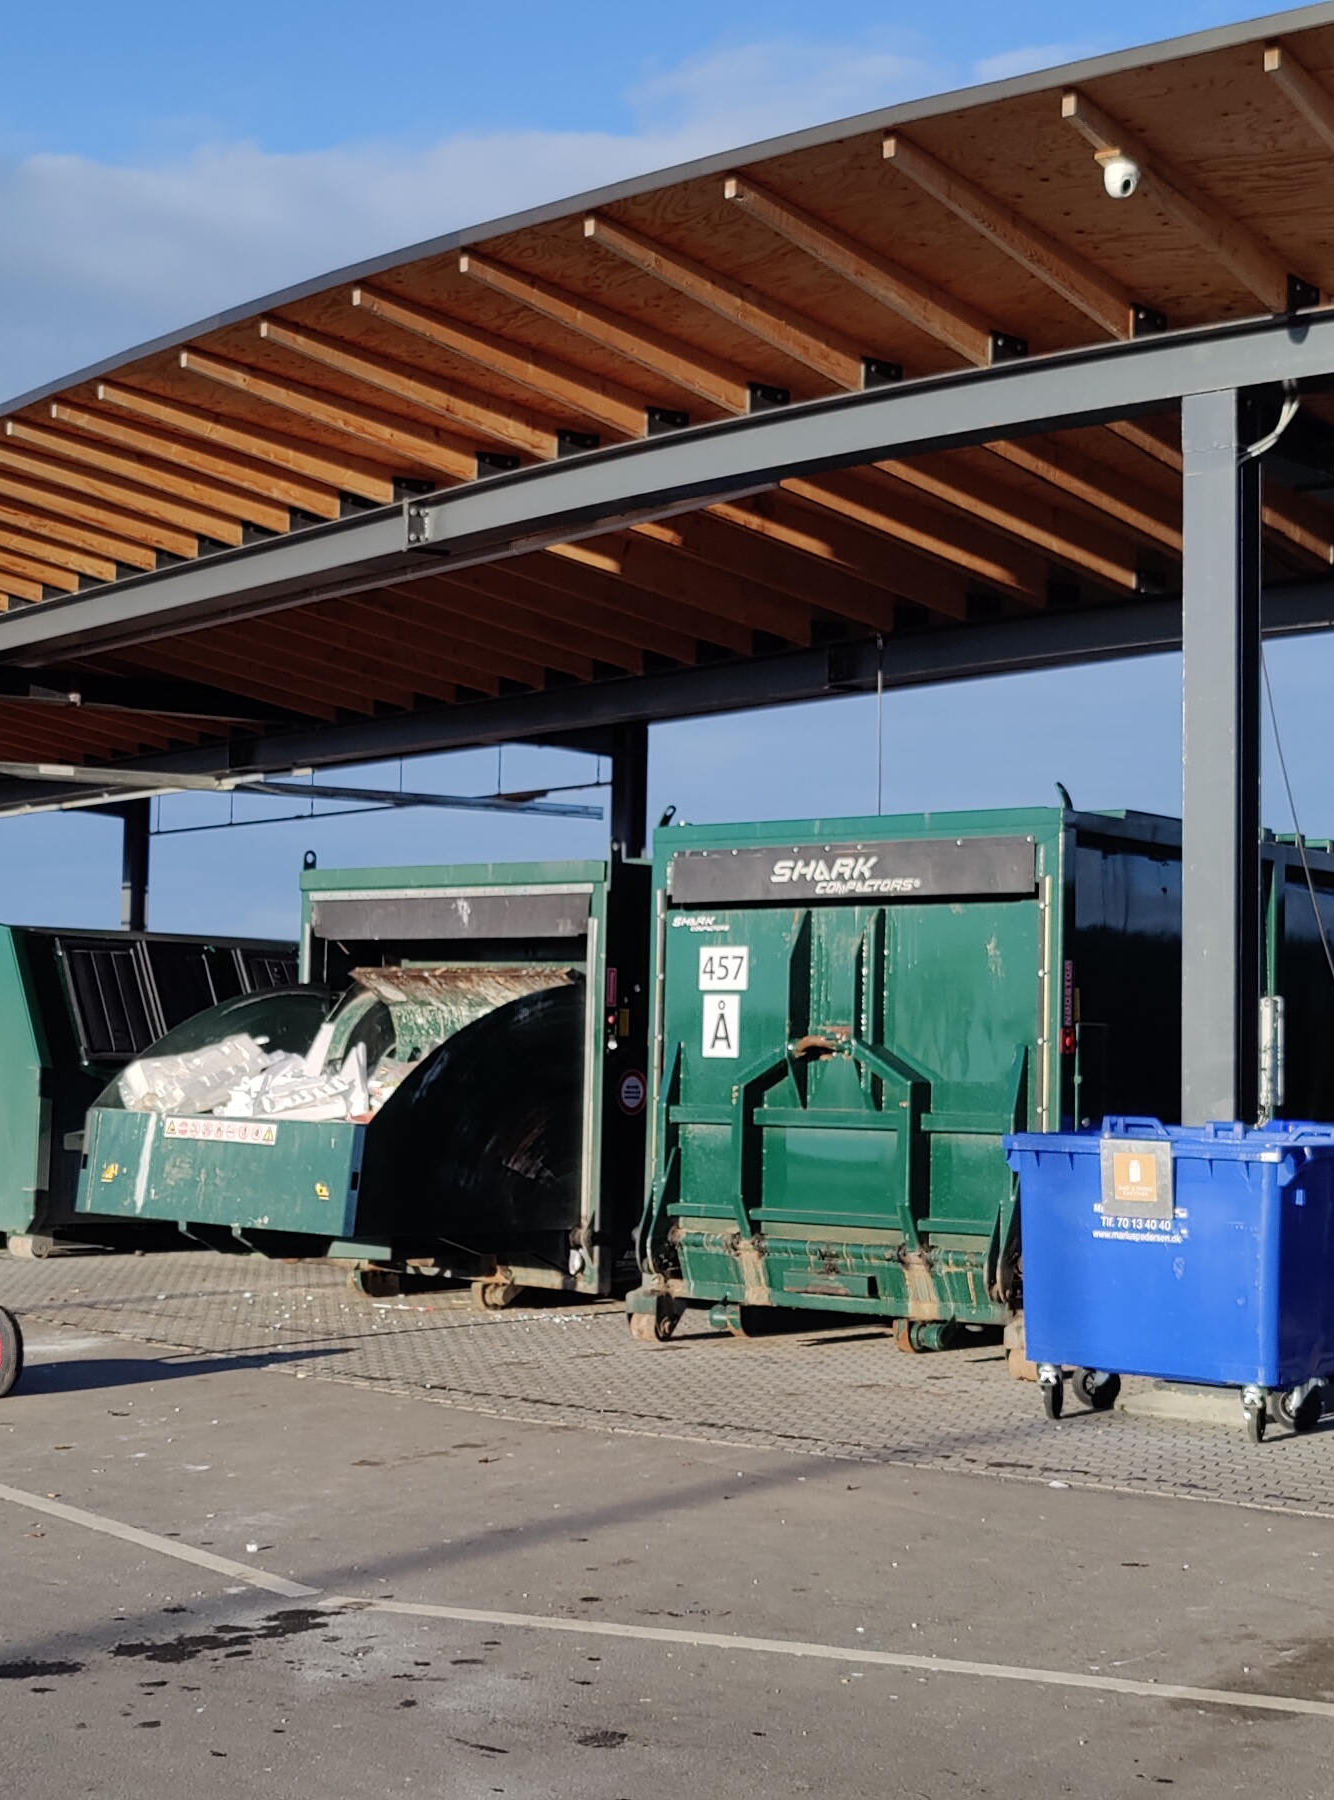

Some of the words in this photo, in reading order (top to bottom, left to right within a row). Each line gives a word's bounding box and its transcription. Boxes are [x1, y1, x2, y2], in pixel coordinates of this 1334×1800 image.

[770, 856, 878, 883] SHARK
[672, 916, 716, 928] SHARK
[702, 956, 744, 981] 457
[710, 1000, 732, 1050] Å
[1100, 1216, 1115, 1228] Tlf.
[1117, 1218, 1128, 1228] 70
[1132, 1219, 1143, 1230] 13
[1144, 1220, 1156, 1230] 40
[1159, 1220, 1171, 1231] 40
[1092, 1230, 1182, 1244] www.mariuspedersen.dk
